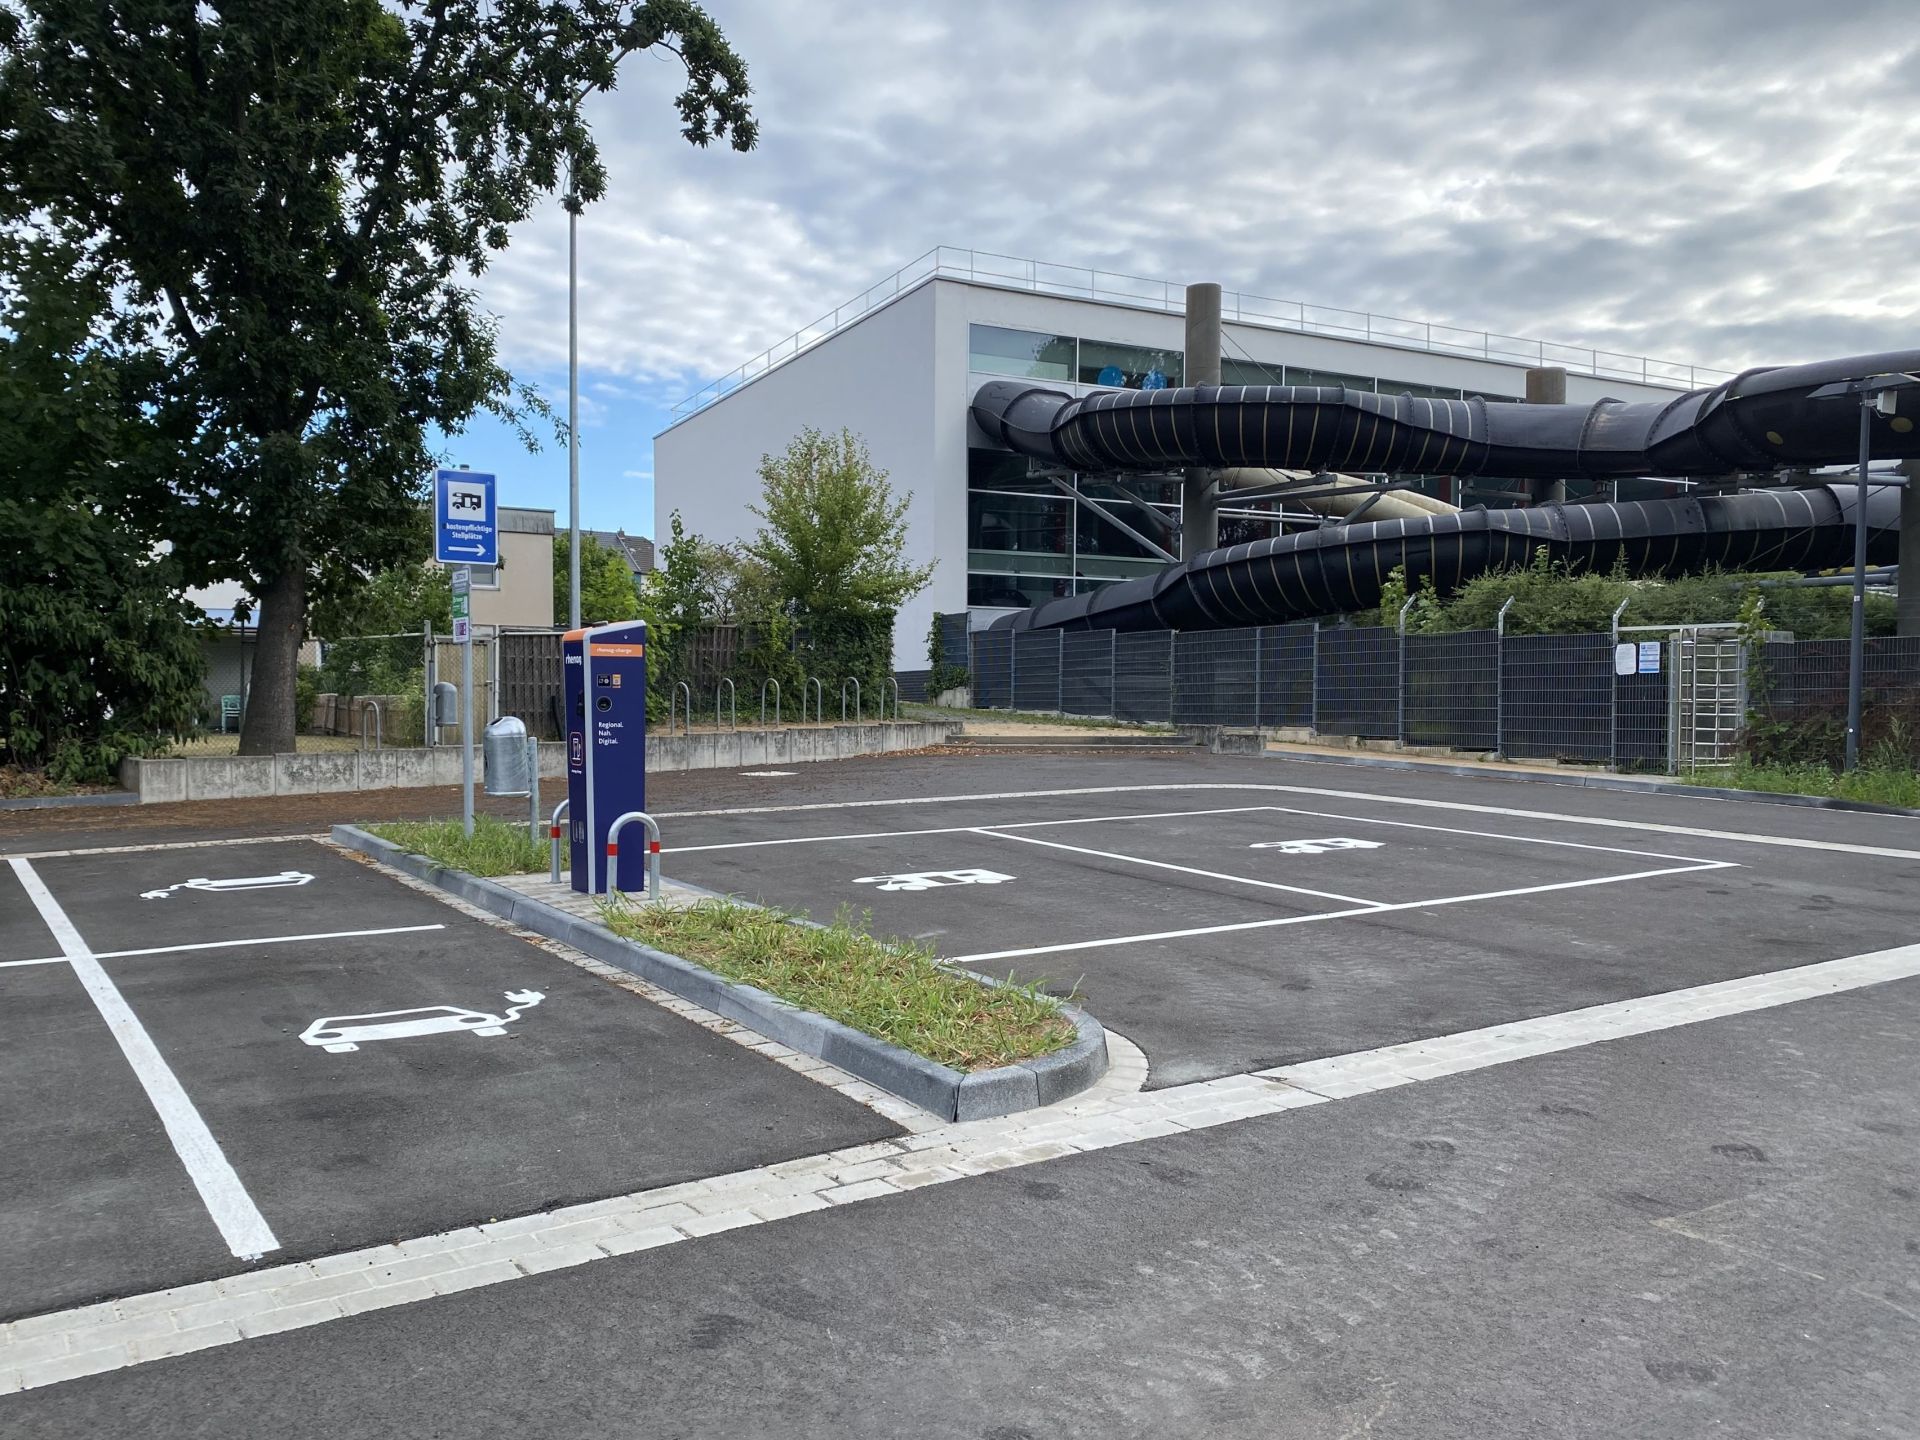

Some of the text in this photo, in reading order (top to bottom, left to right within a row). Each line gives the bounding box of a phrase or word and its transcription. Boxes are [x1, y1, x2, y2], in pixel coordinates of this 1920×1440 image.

[446, 522, 492, 533] kostenpflichtige
[452, 531, 483, 540] Stellplätze
[598, 721, 624, 729] Regional.
